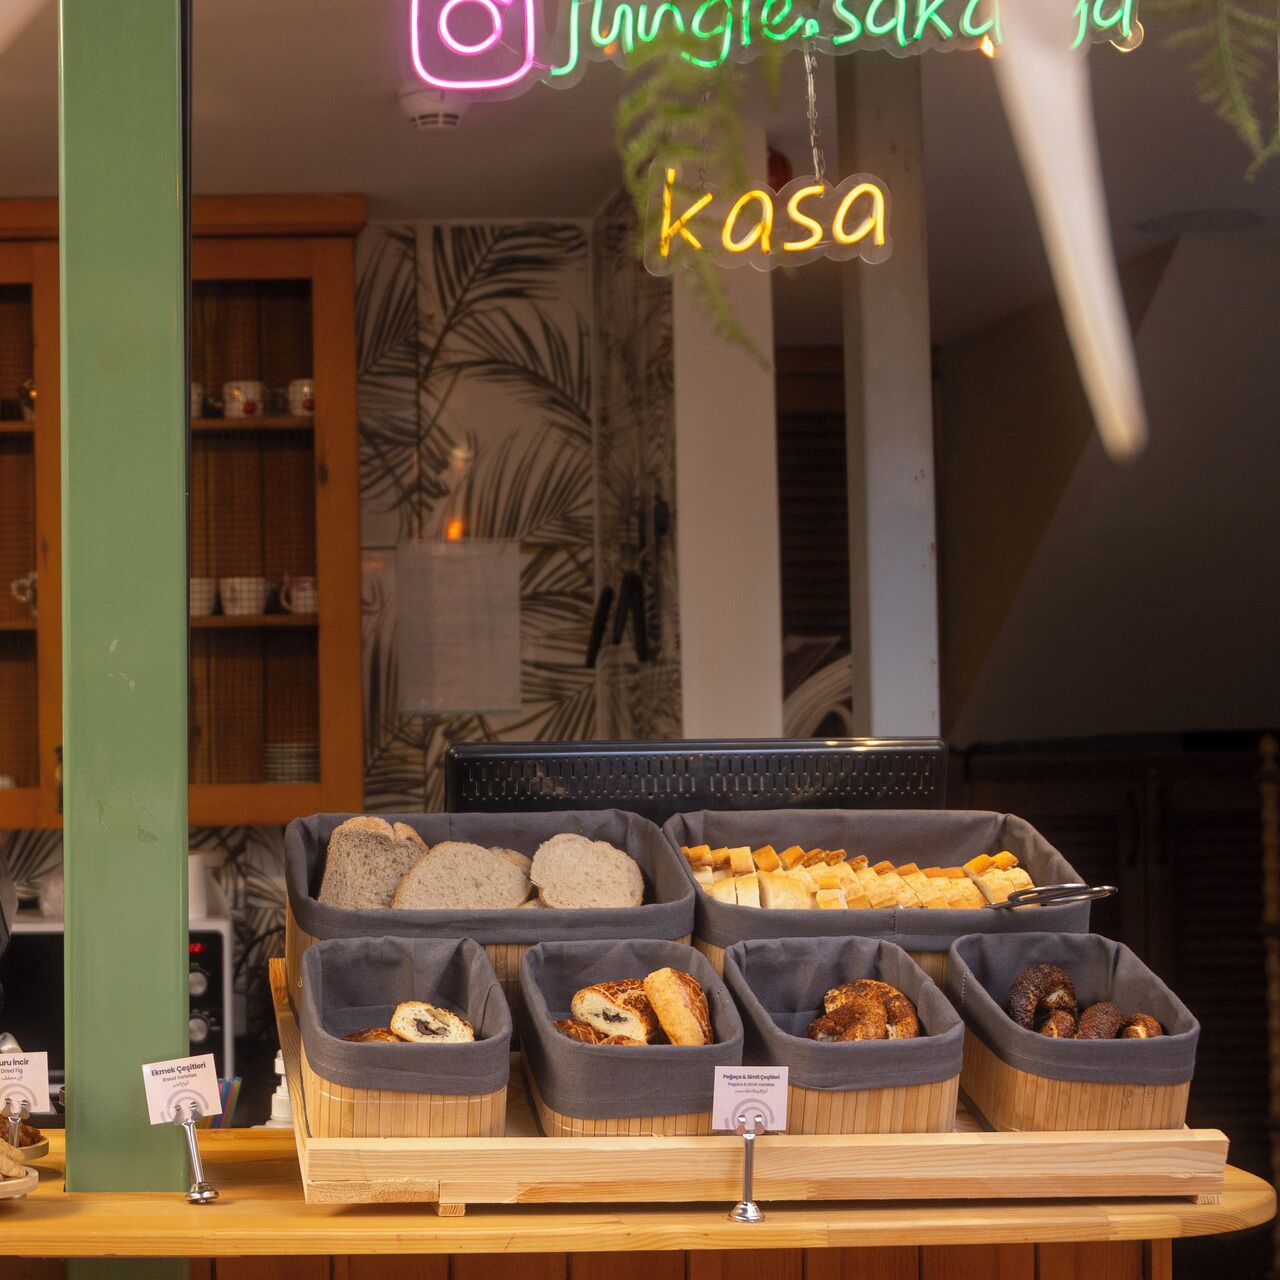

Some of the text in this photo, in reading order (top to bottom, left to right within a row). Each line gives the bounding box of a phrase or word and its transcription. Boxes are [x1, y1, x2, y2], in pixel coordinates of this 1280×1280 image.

[660, 167, 885, 257] kasa
[12, 1057, 29, 1066] İncir
[15, 1067, 23, 1075] Fig
[151, 1061, 207, 1077] Ekmek Çeşitleri
